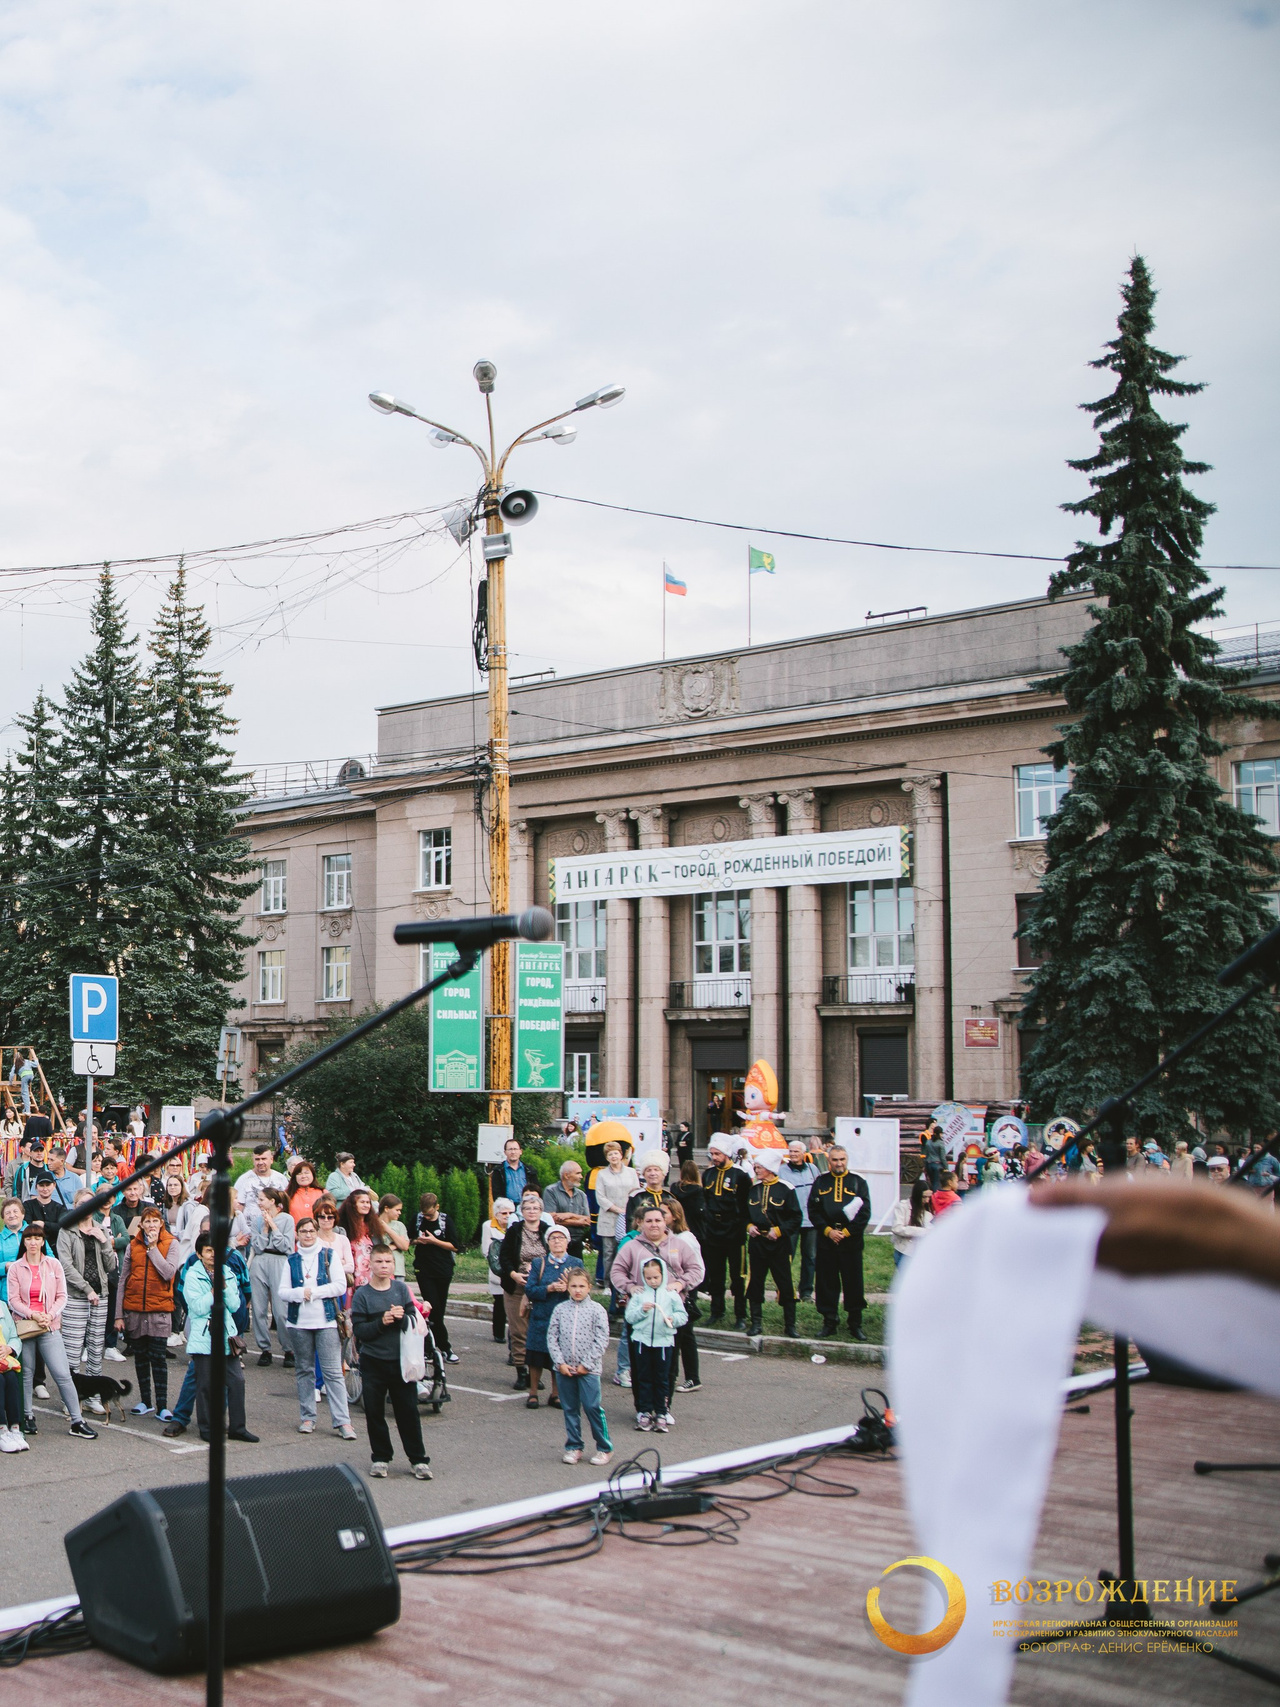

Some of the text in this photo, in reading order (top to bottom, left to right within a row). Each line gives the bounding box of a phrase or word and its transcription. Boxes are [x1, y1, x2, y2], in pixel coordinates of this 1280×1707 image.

[563, 863, 658, 890] АНГАРСК
[674, 862, 720, 878] ГОРОД,
[724, 849, 813, 875] РОЖДЁННЫЙ
[818, 843, 892, 867] ПОБЕДОЙ!
[519, 961, 561, 970] АНГАРСК
[526, 977, 555, 989] ГОРОД,
[444, 988, 470, 999] ГОРОД
[436, 1010, 478, 1020] СИЛЬНЫХ
[519, 1019, 560, 1031] ПОБЕДОЙ!
